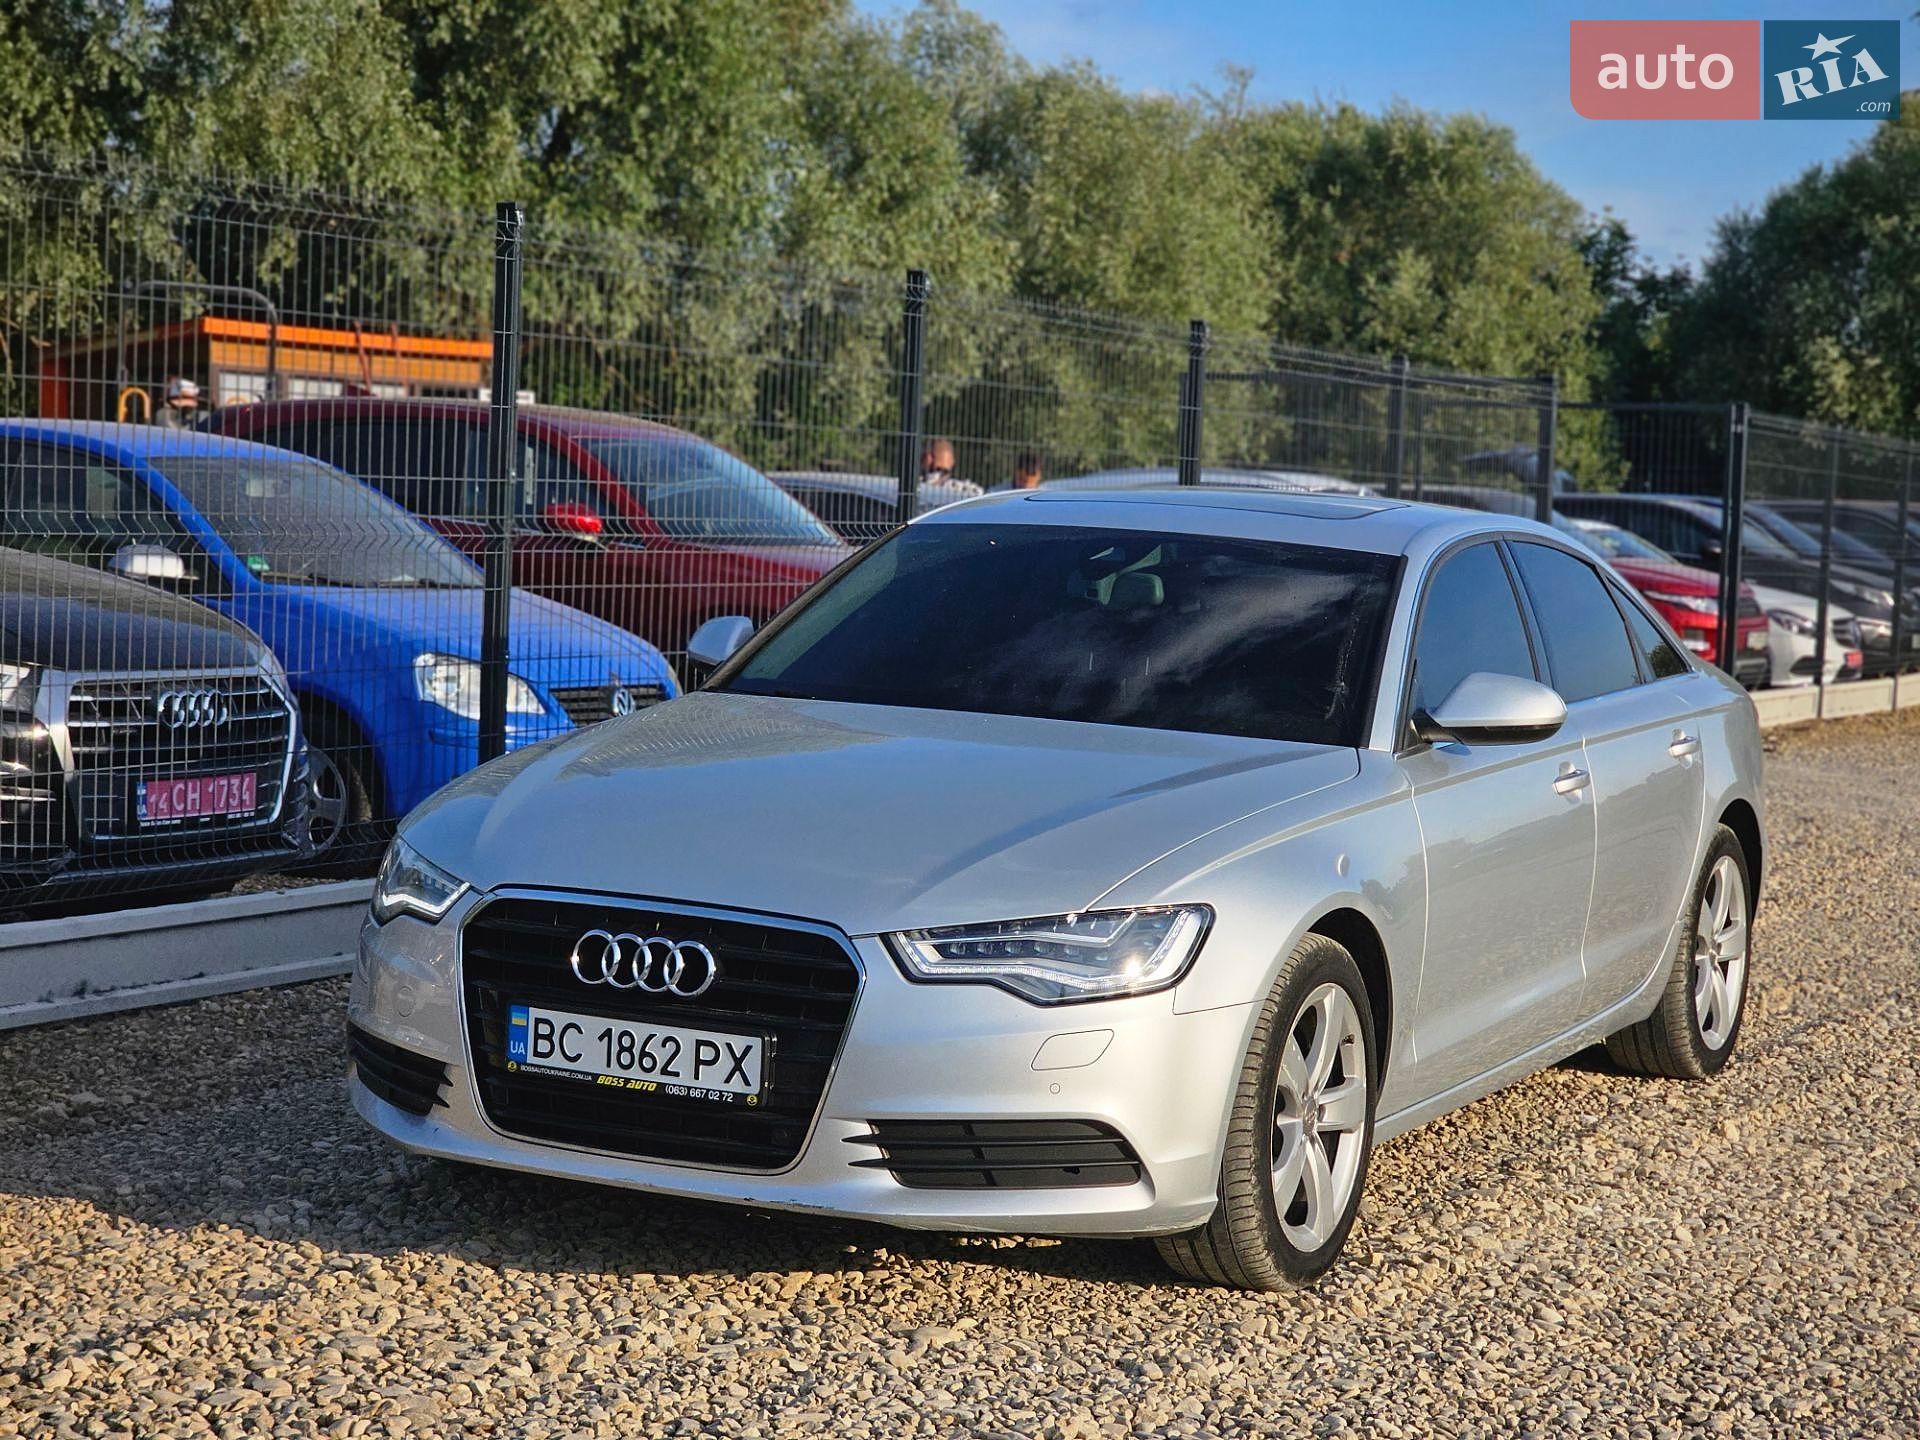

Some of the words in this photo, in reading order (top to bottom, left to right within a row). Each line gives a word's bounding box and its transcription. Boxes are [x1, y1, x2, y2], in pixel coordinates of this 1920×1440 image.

[172, 782, 201, 811] CH
[208, 777, 250, 808] 1734
[509, 1041, 526, 1056] UA
[532, 1017, 584, 1063] BC
[597, 1027, 682, 1078] 1862
[693, 1039, 753, 1087] PX
[597, 1075, 624, 1087] BOSS
[626, 1079, 657, 1092] AUTO
[665, 1085, 688, 1096] (063)
[689, 1088, 706, 1099] 667
[708, 1090, 720, 1100] 02
[722, 1092, 734, 1102] 72
